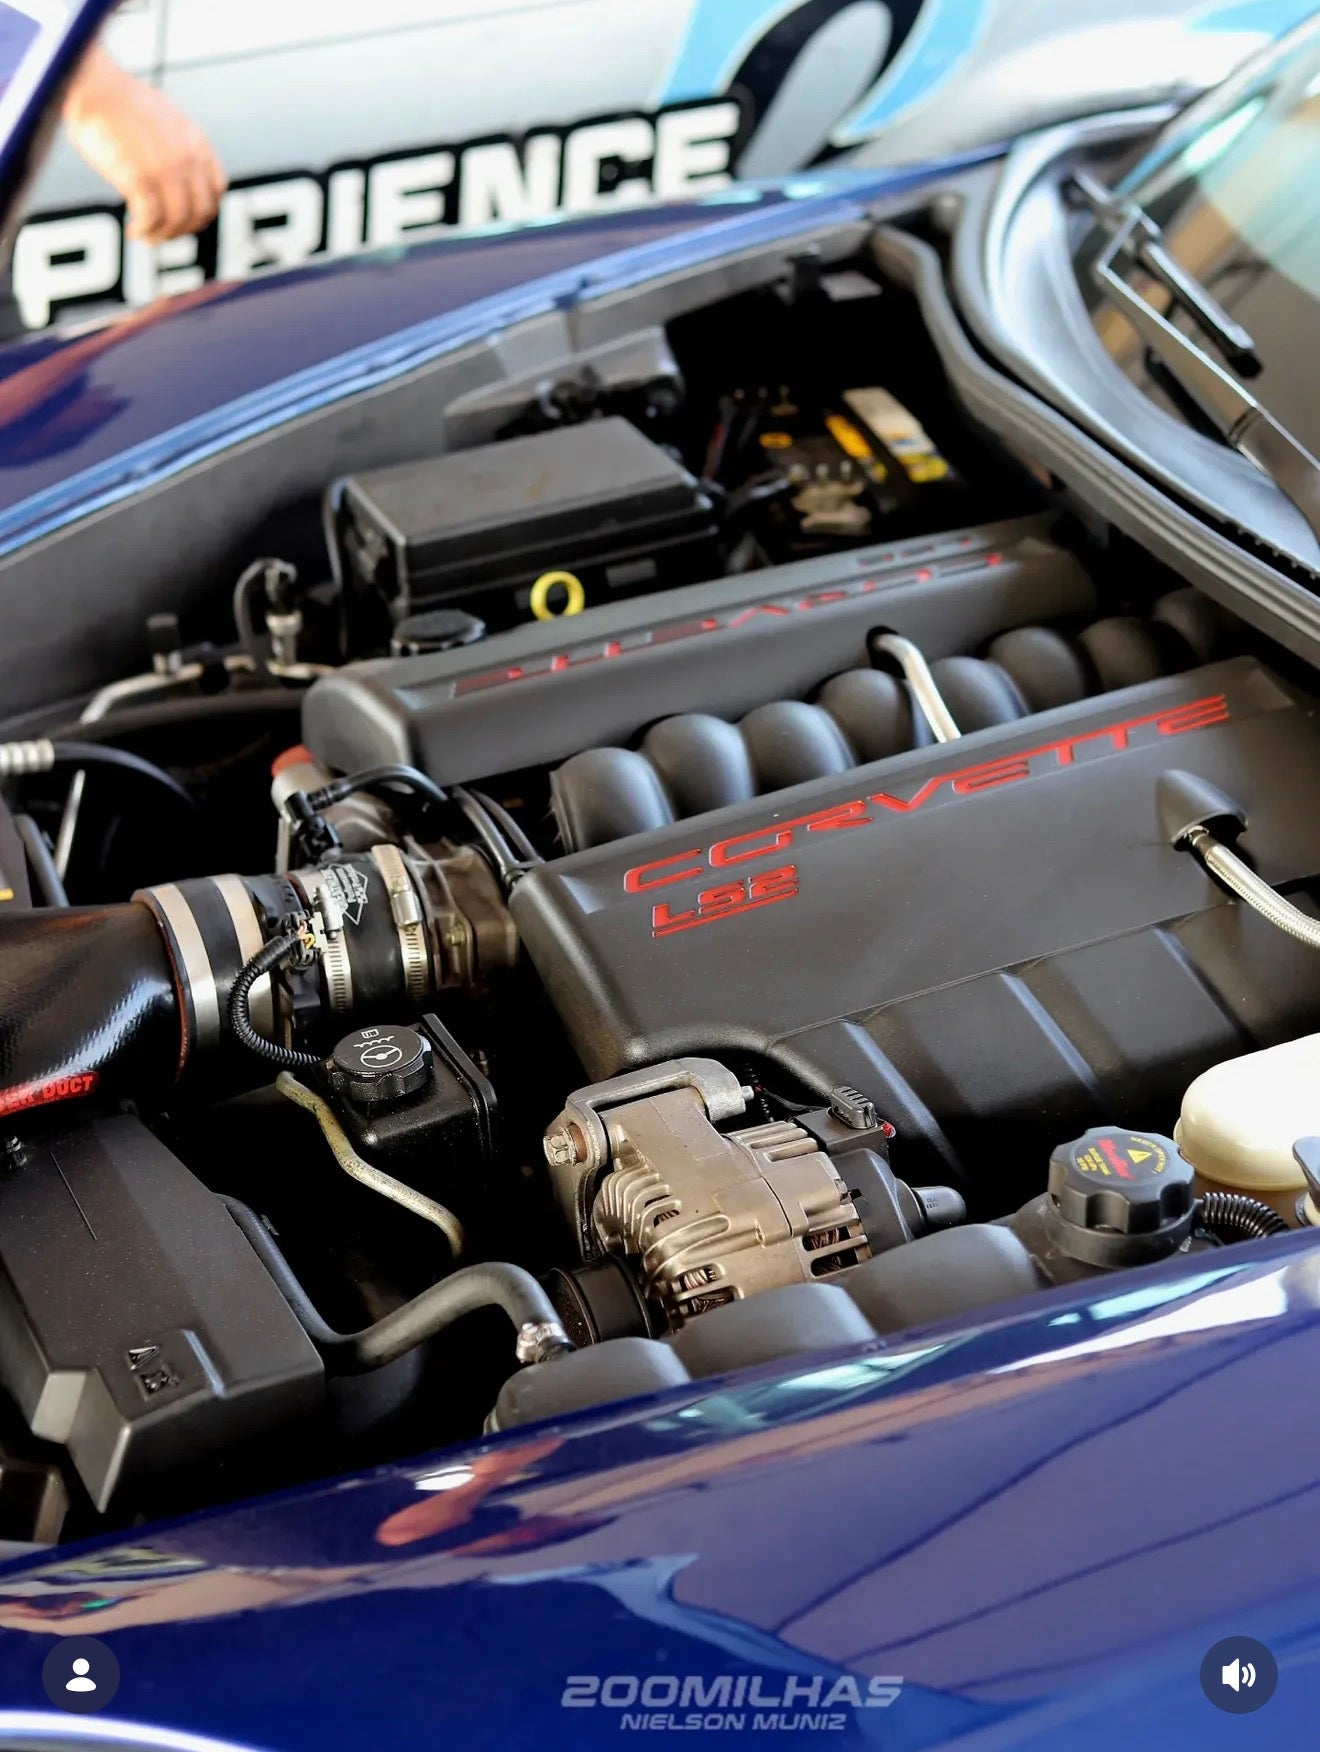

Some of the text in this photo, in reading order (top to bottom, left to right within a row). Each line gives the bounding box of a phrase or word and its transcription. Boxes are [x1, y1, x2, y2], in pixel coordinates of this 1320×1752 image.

[624, 694, 1231, 894] CORVETTE
[652, 864, 799, 929] LS2
[42, 1075, 94, 1099] DUCT
